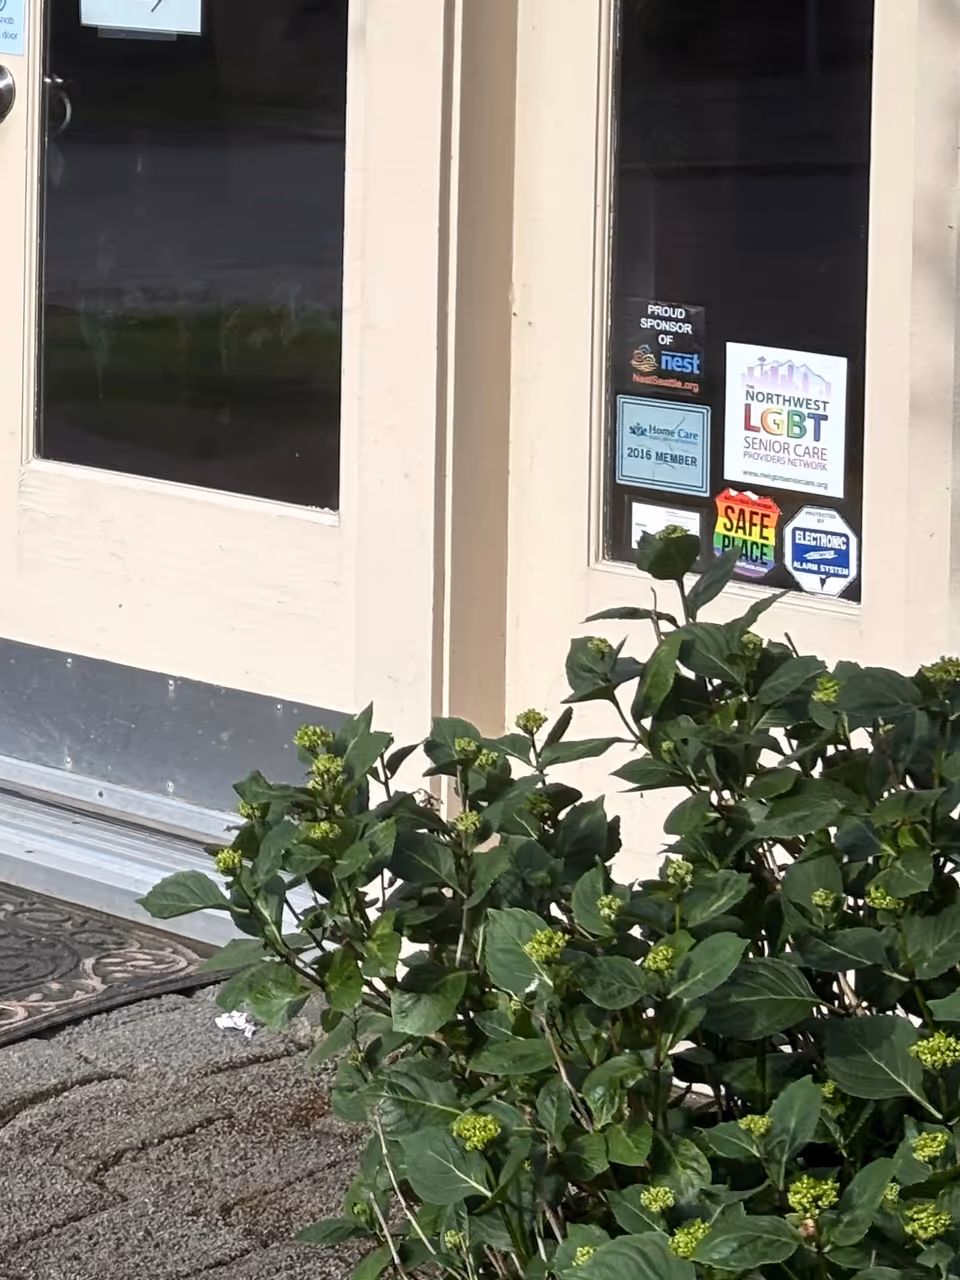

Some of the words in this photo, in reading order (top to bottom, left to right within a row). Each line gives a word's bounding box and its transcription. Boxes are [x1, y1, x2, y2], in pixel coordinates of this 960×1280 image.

[1, 29, 19, 40] door
[648, 304, 686, 319] PROUD
[640, 317, 693, 335] SPONSOR
[658, 334, 674, 346] OF
[660, 353, 700, 375] nest
[745, 389, 830, 413] NORTHWEST
[648, 424, 676, 438] Home
[677, 428, 699, 441] Care
[743, 402, 829, 443] LGBT
[626, 446, 652, 460] 2016
[655, 451, 698, 468] MEMBER
[743, 435, 791, 456] SENIOR
[793, 443, 829, 462] CARE
[743, 450, 786, 465] PROVIDERS
[787, 457, 829, 472] NETWORK
[723, 504, 771, 541] SAFE
[795, 530, 848, 551] ELECTRONIC
[793, 560, 819, 572] ALARM
[819, 564, 849, 576] SYSTEM
